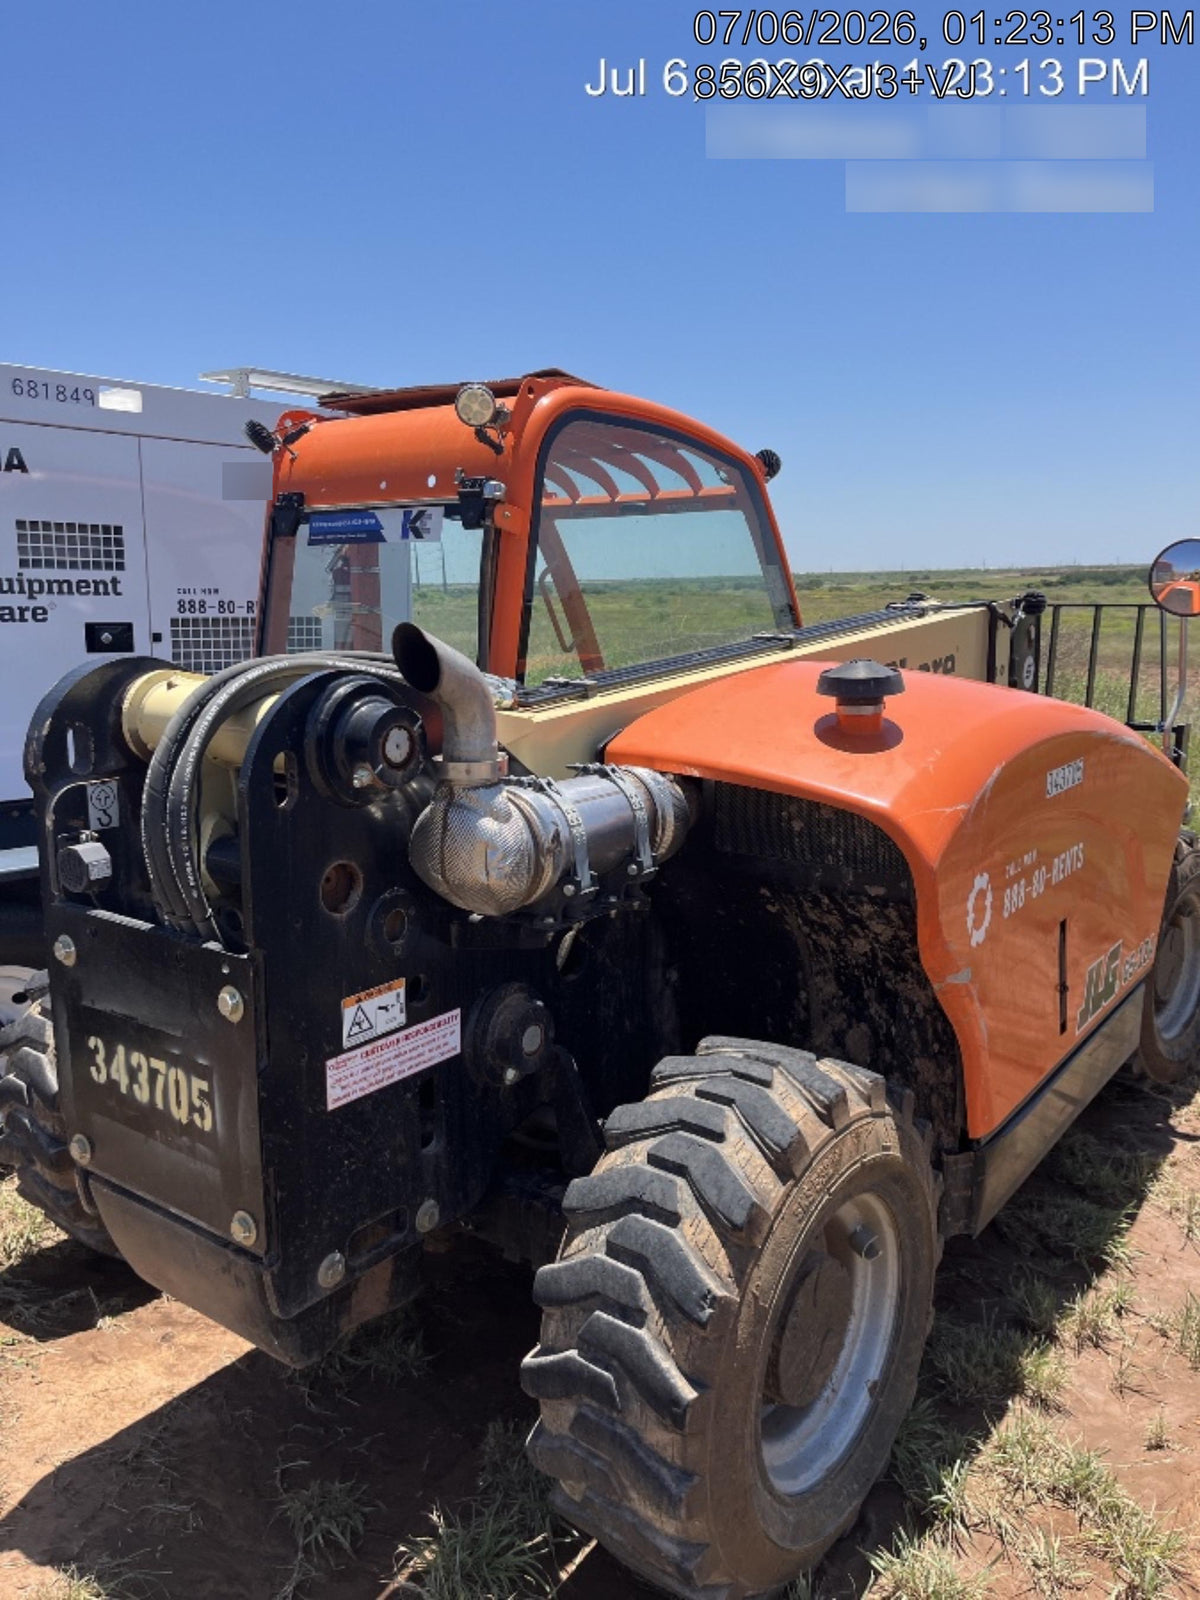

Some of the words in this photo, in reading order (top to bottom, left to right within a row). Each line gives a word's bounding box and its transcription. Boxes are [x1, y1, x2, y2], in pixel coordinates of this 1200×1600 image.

[12, 378, 95, 406] 681849
[0, 447, 29, 473] A
[0, 572, 123, 600] uipment
[177, 599, 258, 614] 888-80-R
[1003, 842, 1084, 919] 888-80-RENTS
[1076, 939, 1123, 1036] JLG
[88, 1036, 212, 1131] 343705
